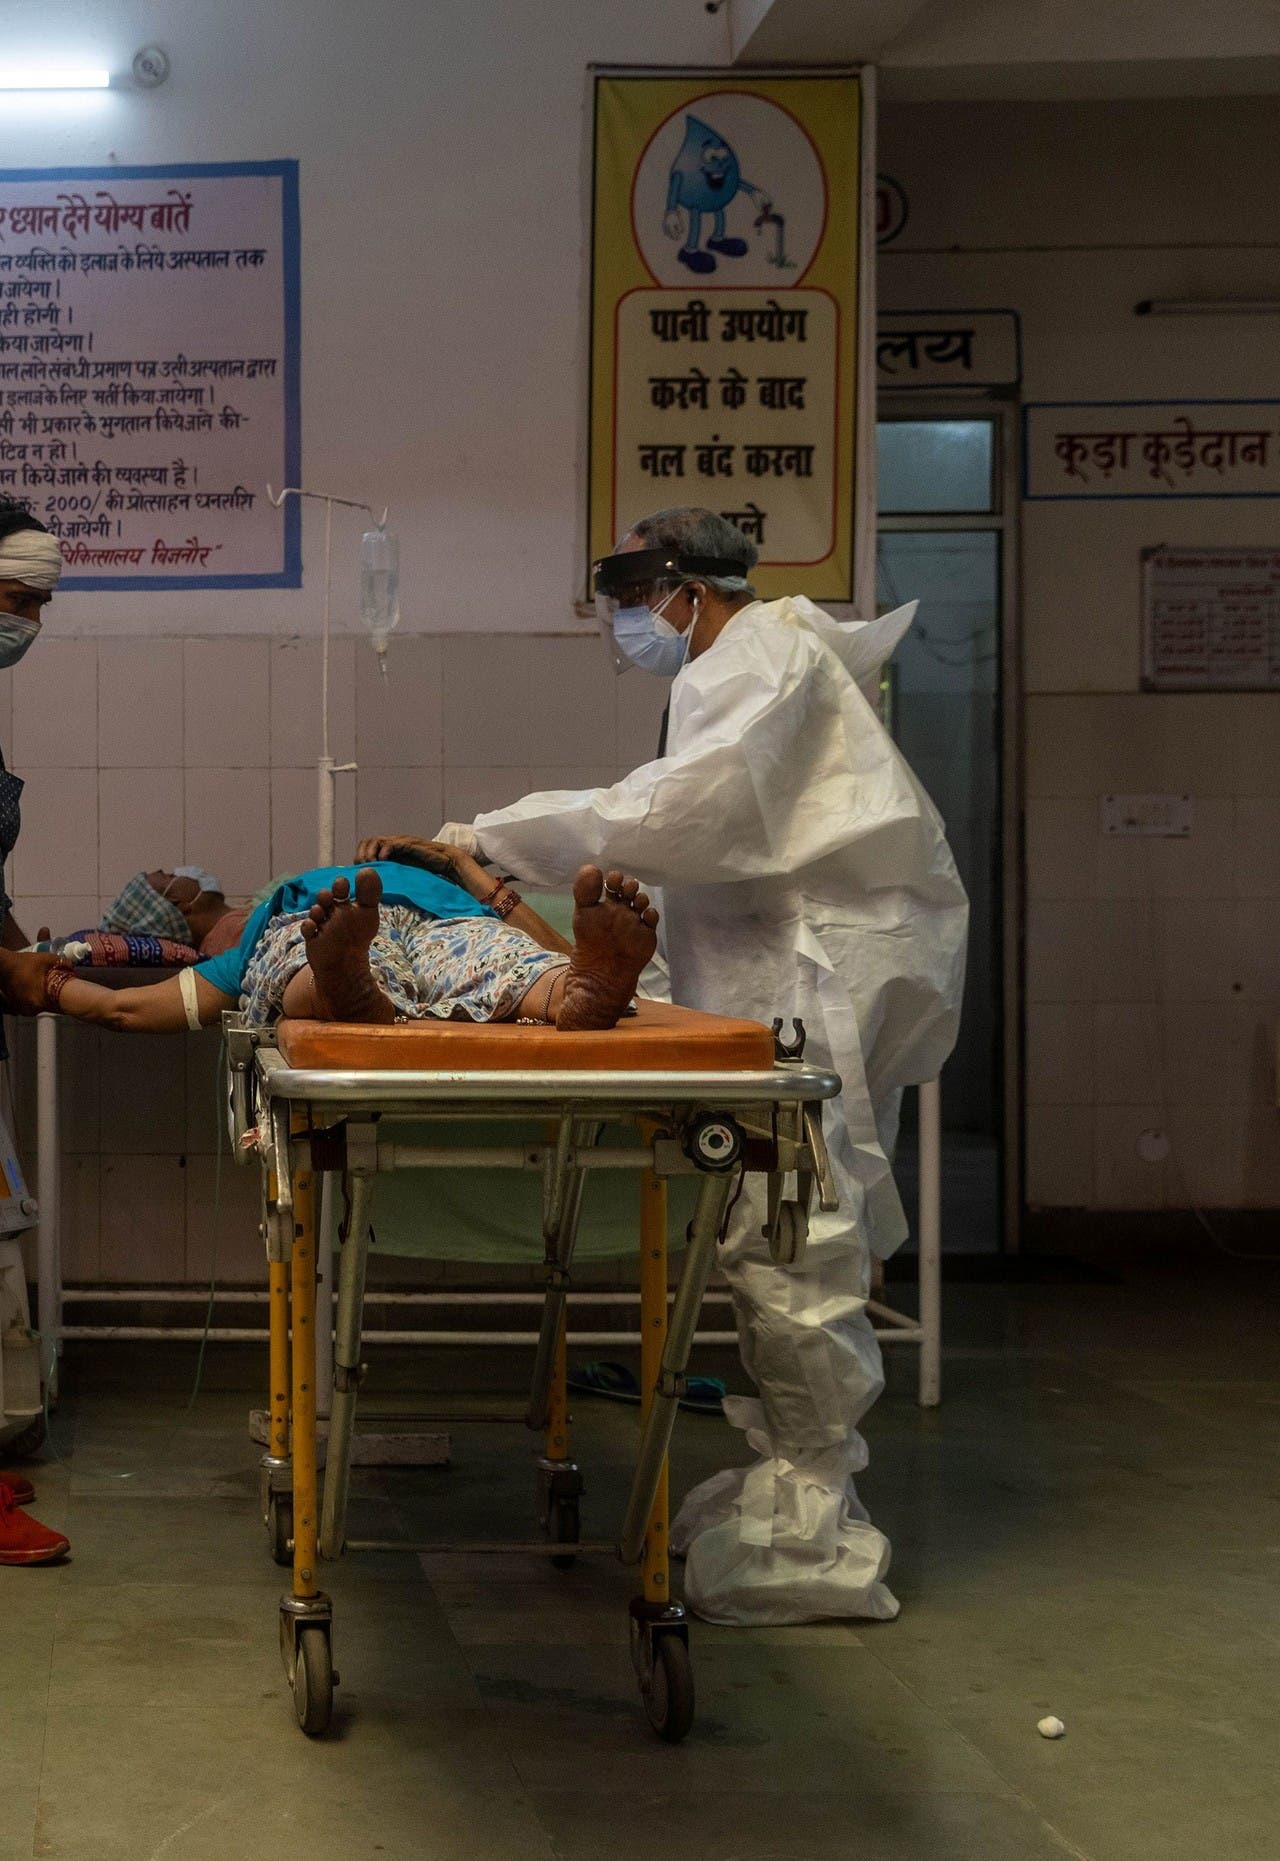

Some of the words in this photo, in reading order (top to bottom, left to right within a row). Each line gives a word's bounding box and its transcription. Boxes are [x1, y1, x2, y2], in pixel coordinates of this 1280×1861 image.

[8, 206, 62, 236] ध्यान
[57, 194, 92, 240] देने
[95, 191, 146, 234] योग्य
[149, 189, 194, 235] बातें
[166, 250, 230, 271] अस्पताल
[233, 249, 267, 271] तक
[22, 302, 61, 329] होगी
[648, 300, 711, 342] पानी
[719, 299, 809, 342] उपयोग
[648, 367, 710, 410] करने
[718, 367, 748, 410] के
[756, 377, 807, 410] बाद
[31, 445, 44, 461] न
[47, 438, 66, 465] हो
[637, 444, 687, 477] नल
[693, 434, 735, 477] बंद
[742, 444, 815, 477] करना
[1055, 432, 1137, 484] कूड़ा
[1143, 416, 1272, 488] कूड़ेदान
[91, 460, 112, 486] की
[171, 458, 189, 489] है
[105, 487, 124, 512] की
